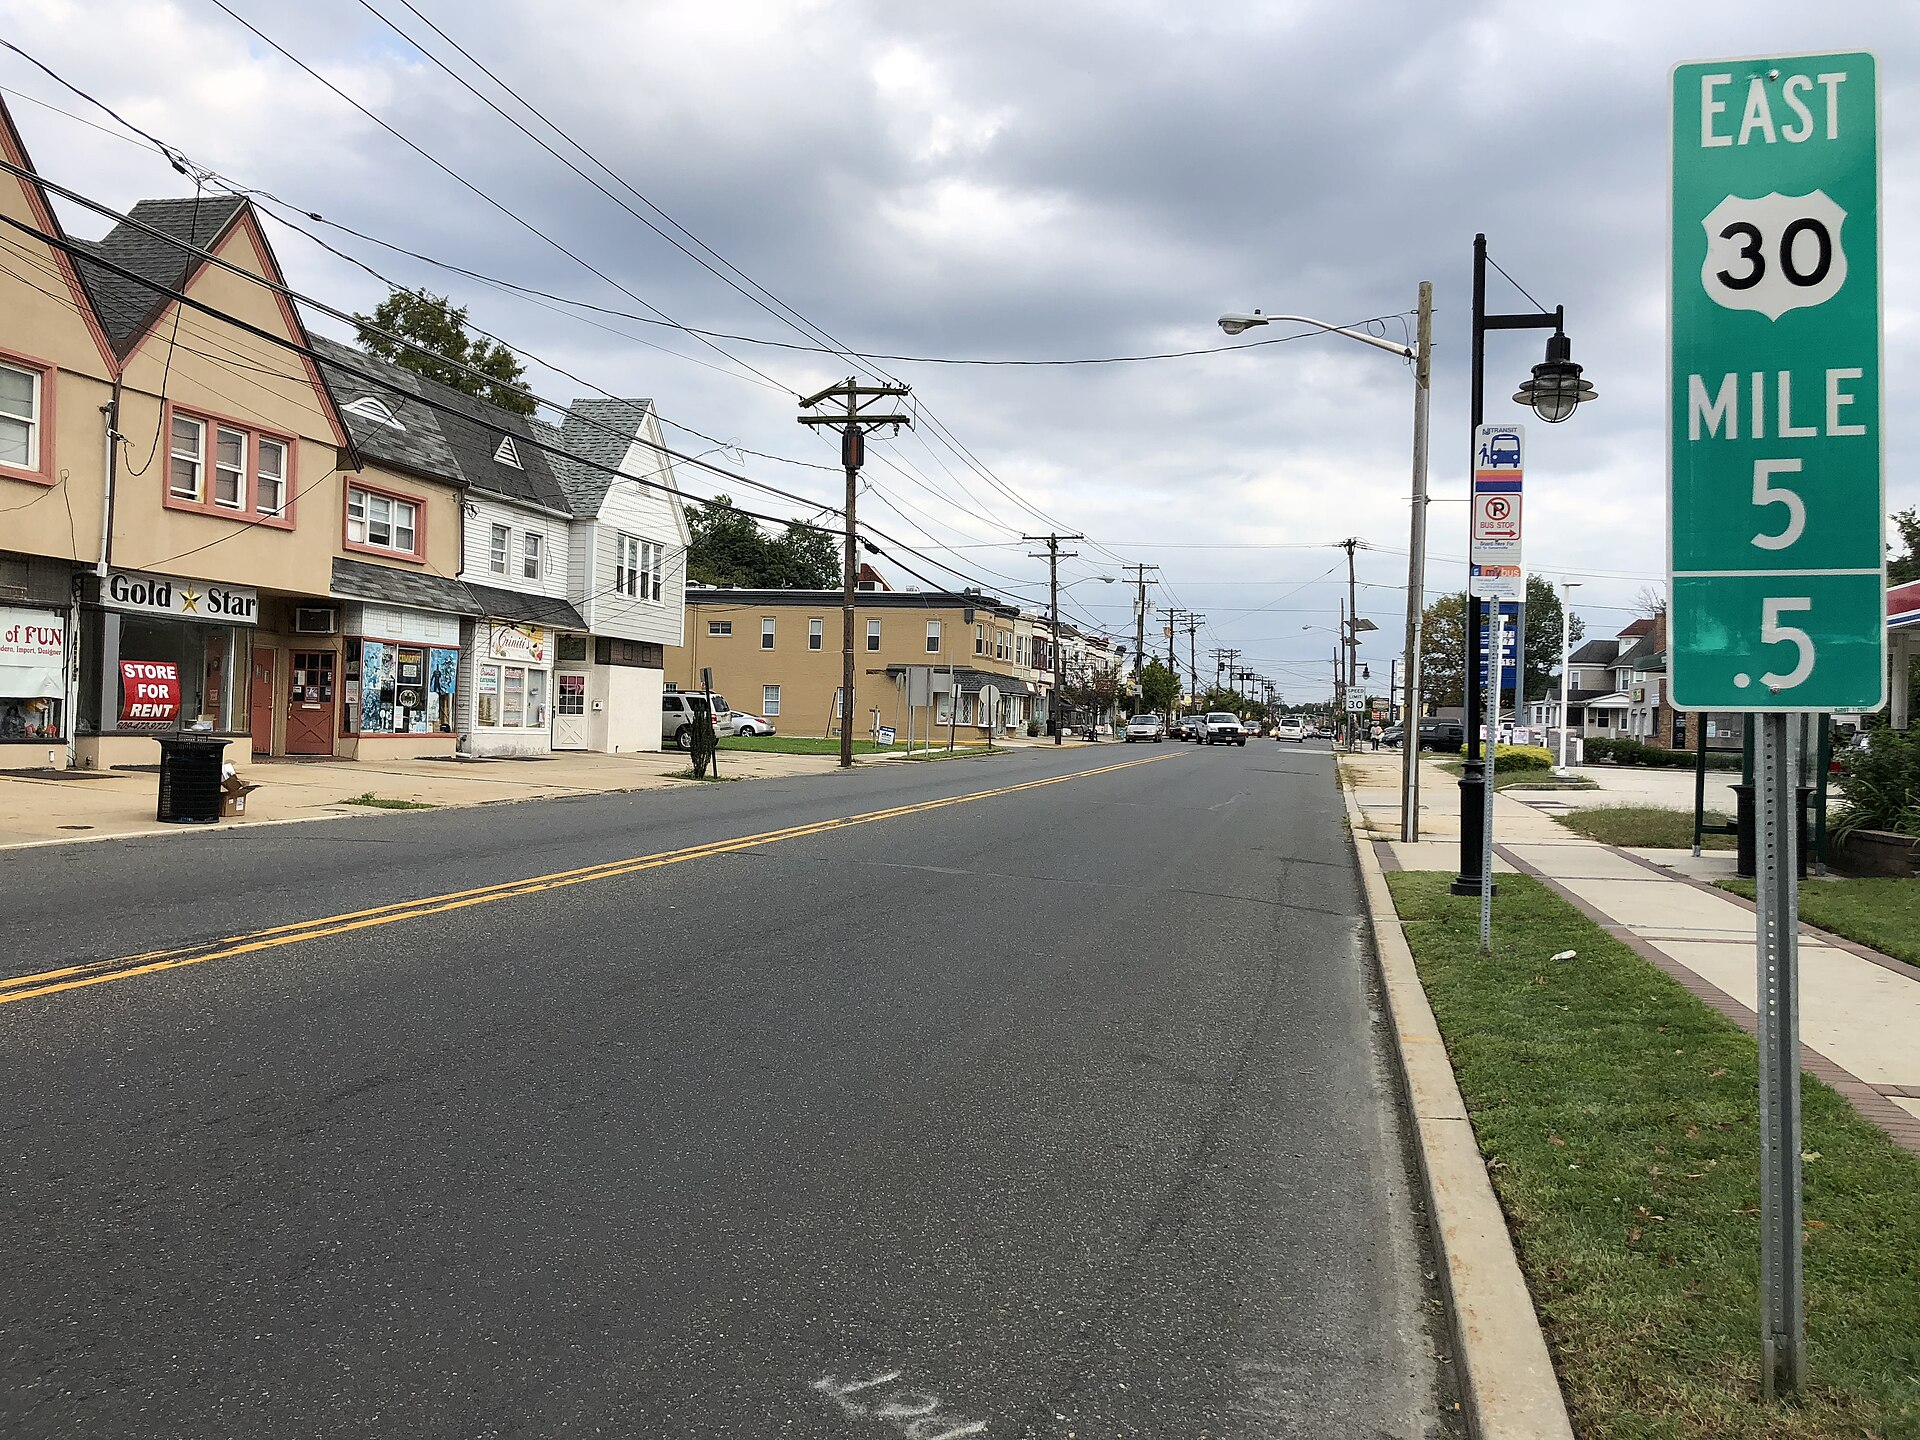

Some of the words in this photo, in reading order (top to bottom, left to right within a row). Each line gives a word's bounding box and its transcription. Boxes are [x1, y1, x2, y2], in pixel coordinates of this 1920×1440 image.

[1701, 72, 1848, 148] EAST
[1716, 217, 1832, 291] 30
[1688, 368, 1866, 441] MILE
[1750, 458, 1806, 550] 5
[1480, 521, 1495, 529] BUS
[1496, 521, 1515, 529] STOP
[110, 574, 172, 608] Gold
[207, 587, 256, 617] Star
[5, 624, 21, 643] of
[24, 625, 62, 647] FUN
[1733, 597, 1816, 690] .5
[37, 647, 62, 657] Designer
[123, 663, 177, 680] STORE
[137, 683, 170, 699] FOR
[129, 703, 174, 718] RENT
[1347, 700, 1364, 709] 30
